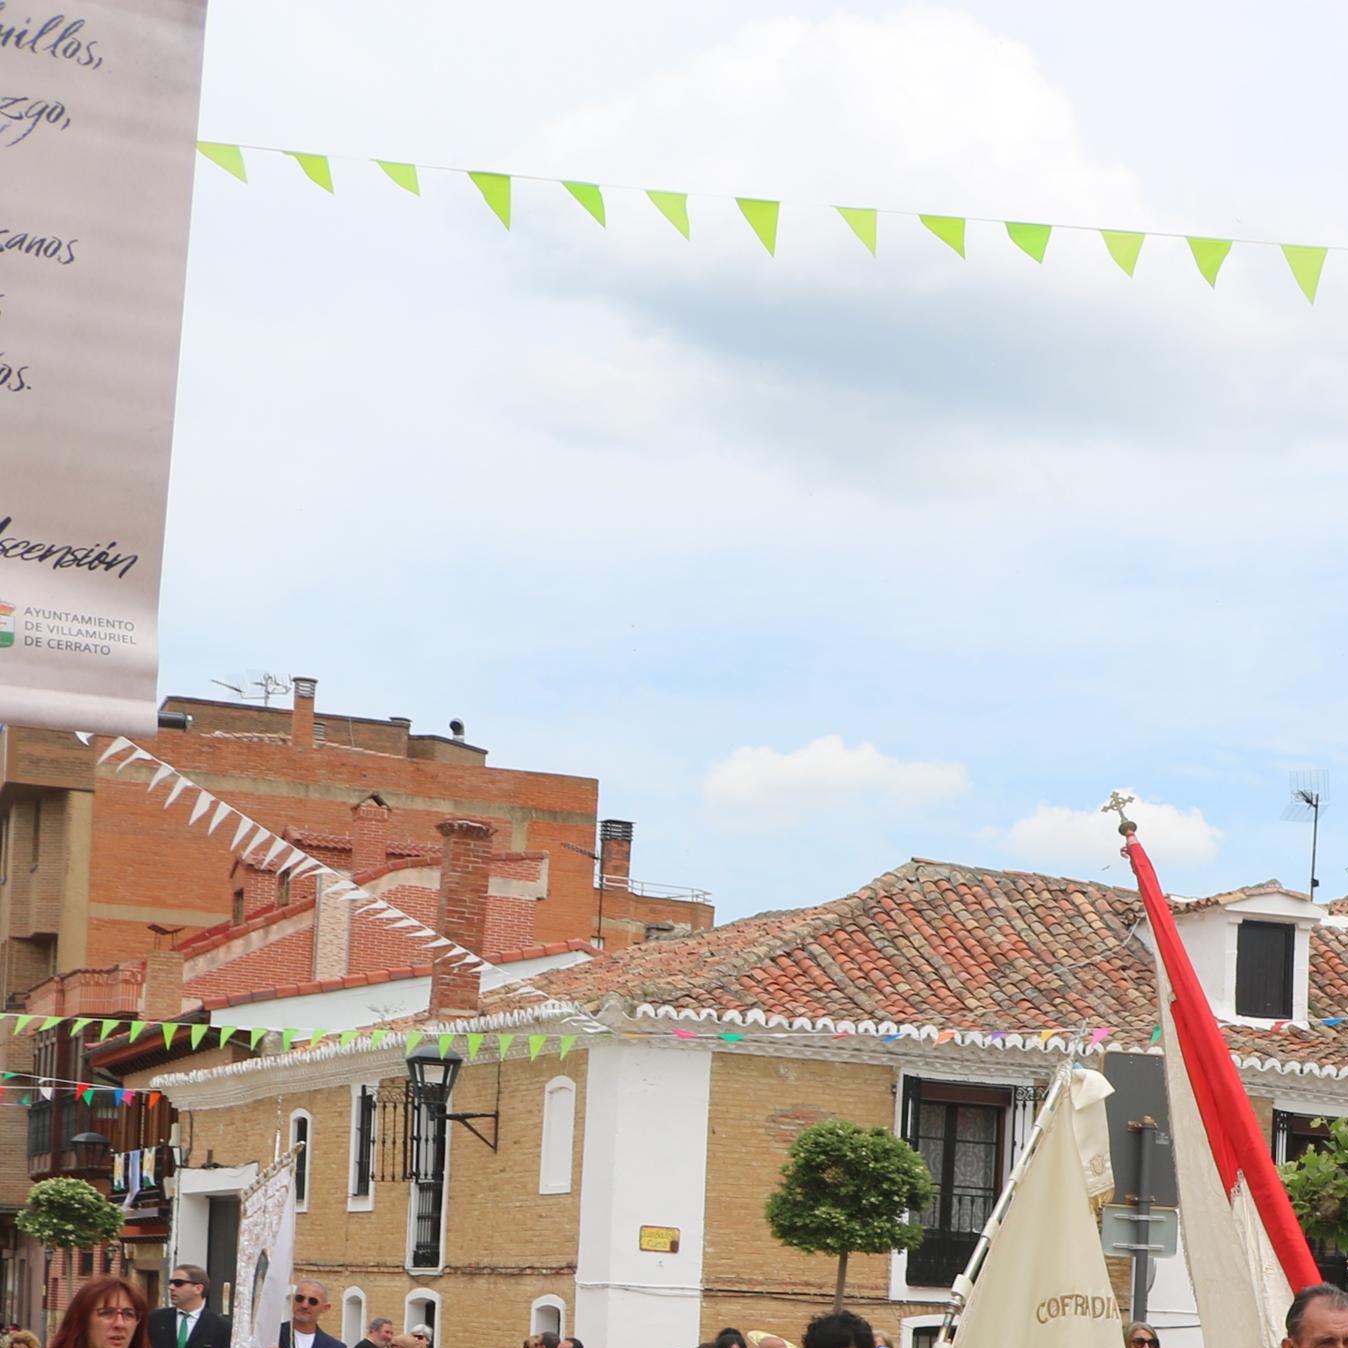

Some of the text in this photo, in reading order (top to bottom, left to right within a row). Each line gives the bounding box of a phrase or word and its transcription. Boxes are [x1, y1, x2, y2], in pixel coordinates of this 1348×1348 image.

[0, 516, 138, 579] scensión
[24, 606, 136, 632] AYUNTAMIENTO
[24, 620, 137, 645] DE VILLAMURIEL
[24, 635, 111, 656] DE CERRATO
